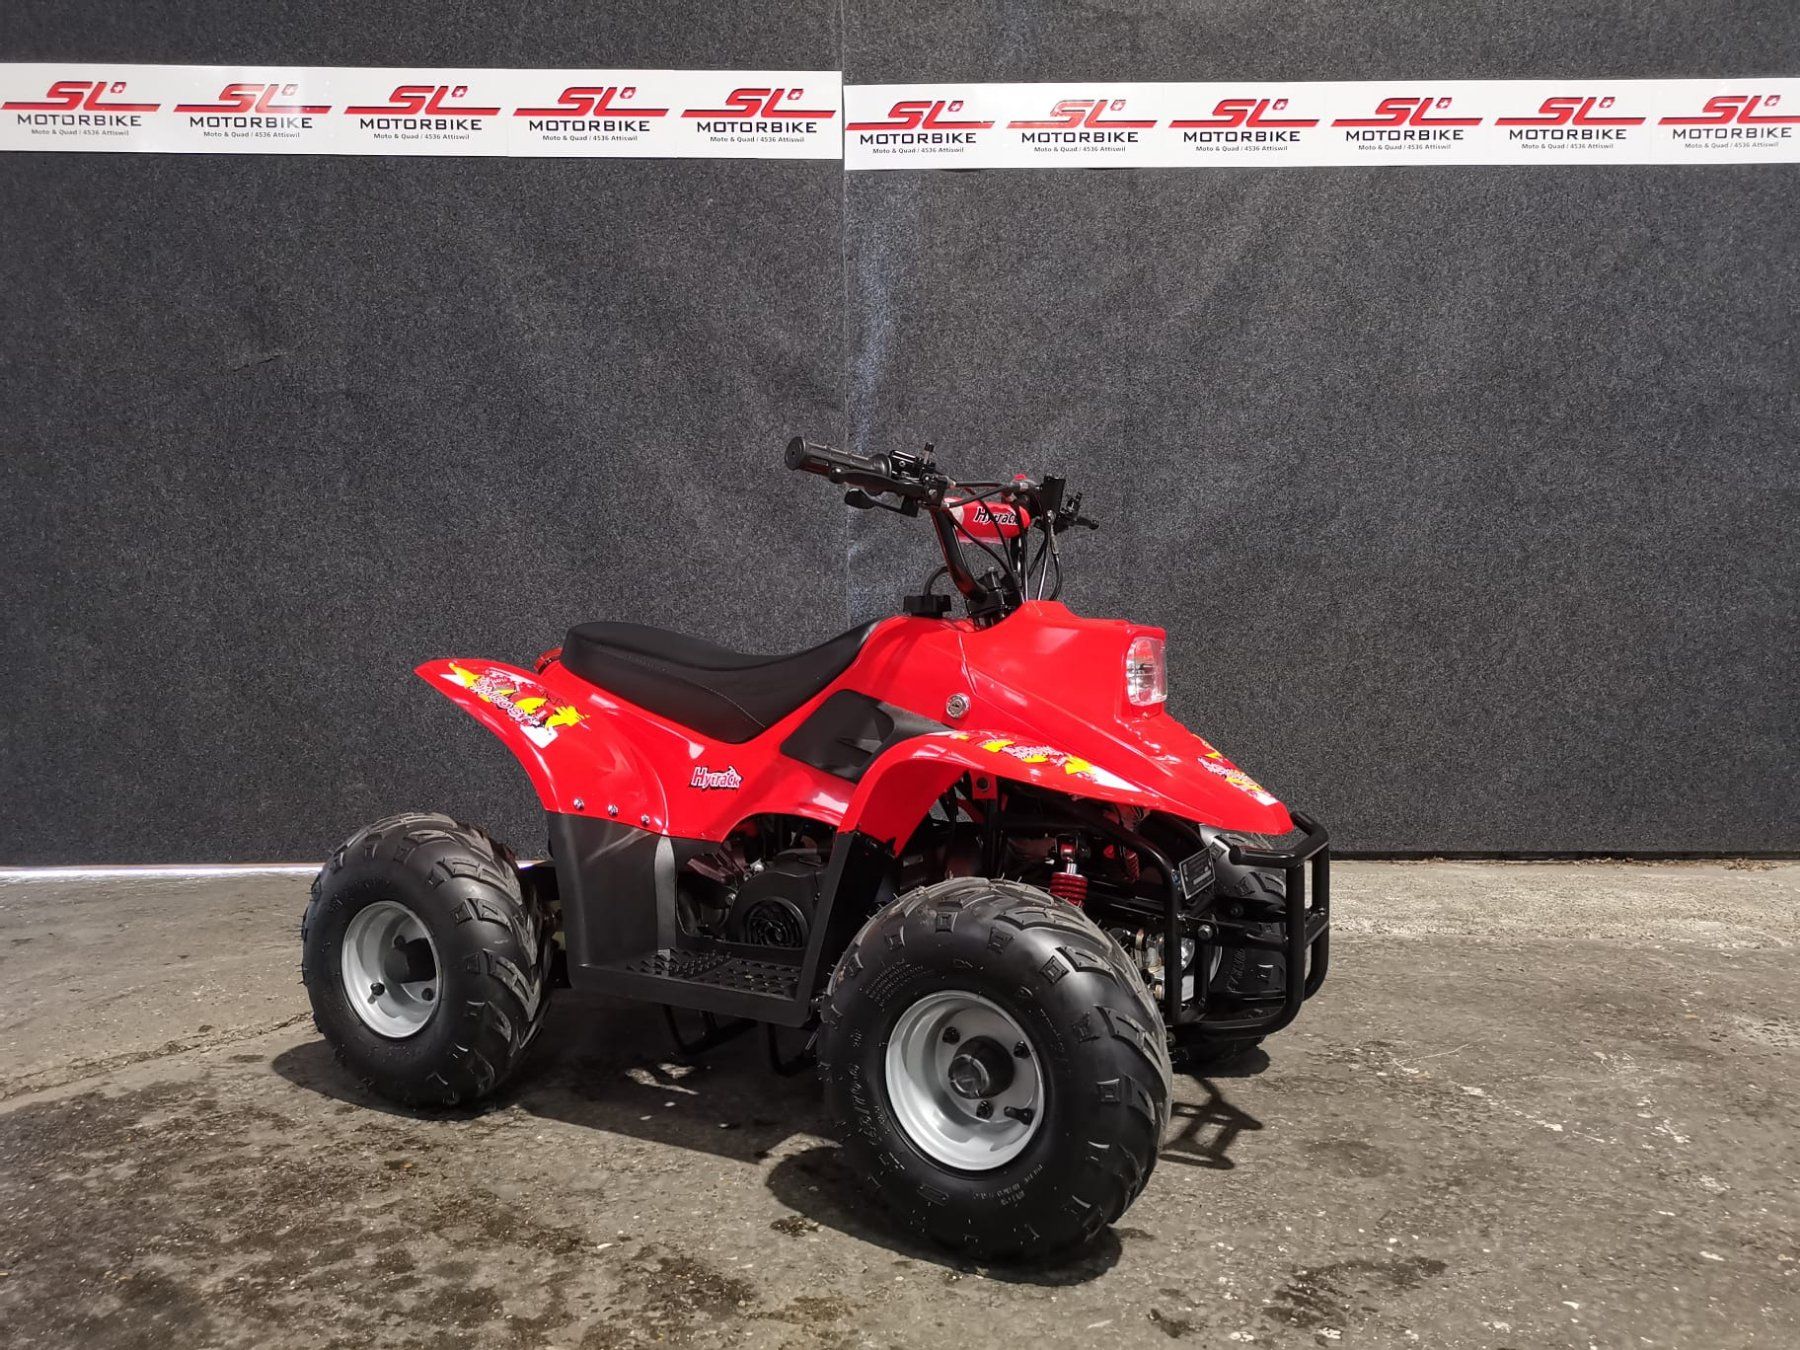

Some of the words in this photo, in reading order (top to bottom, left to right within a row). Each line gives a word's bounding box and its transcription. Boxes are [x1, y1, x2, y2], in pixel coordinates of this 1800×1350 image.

[18, 114, 141, 126] MOTORBIKE
[190, 116, 312, 128] MOTORBIKE
[360, 118, 482, 130] MOTORBIKE
[530, 120, 650, 131] MOTORBIKE
[697, 122, 817, 133] MOTORBIKE
[1672, 127, 1791, 139] MOTORBIKE
[860, 133, 976, 144] MOTORBIKE
[1022, 132, 1138, 142] MOTORBIKE
[1184, 131, 1300, 142] MOTORBIKE
[1346, 130, 1463, 141] MOTORBIKE
[1510, 129, 1626, 140] MOTORBIKE
[691, 766, 740, 789] Hytrack
